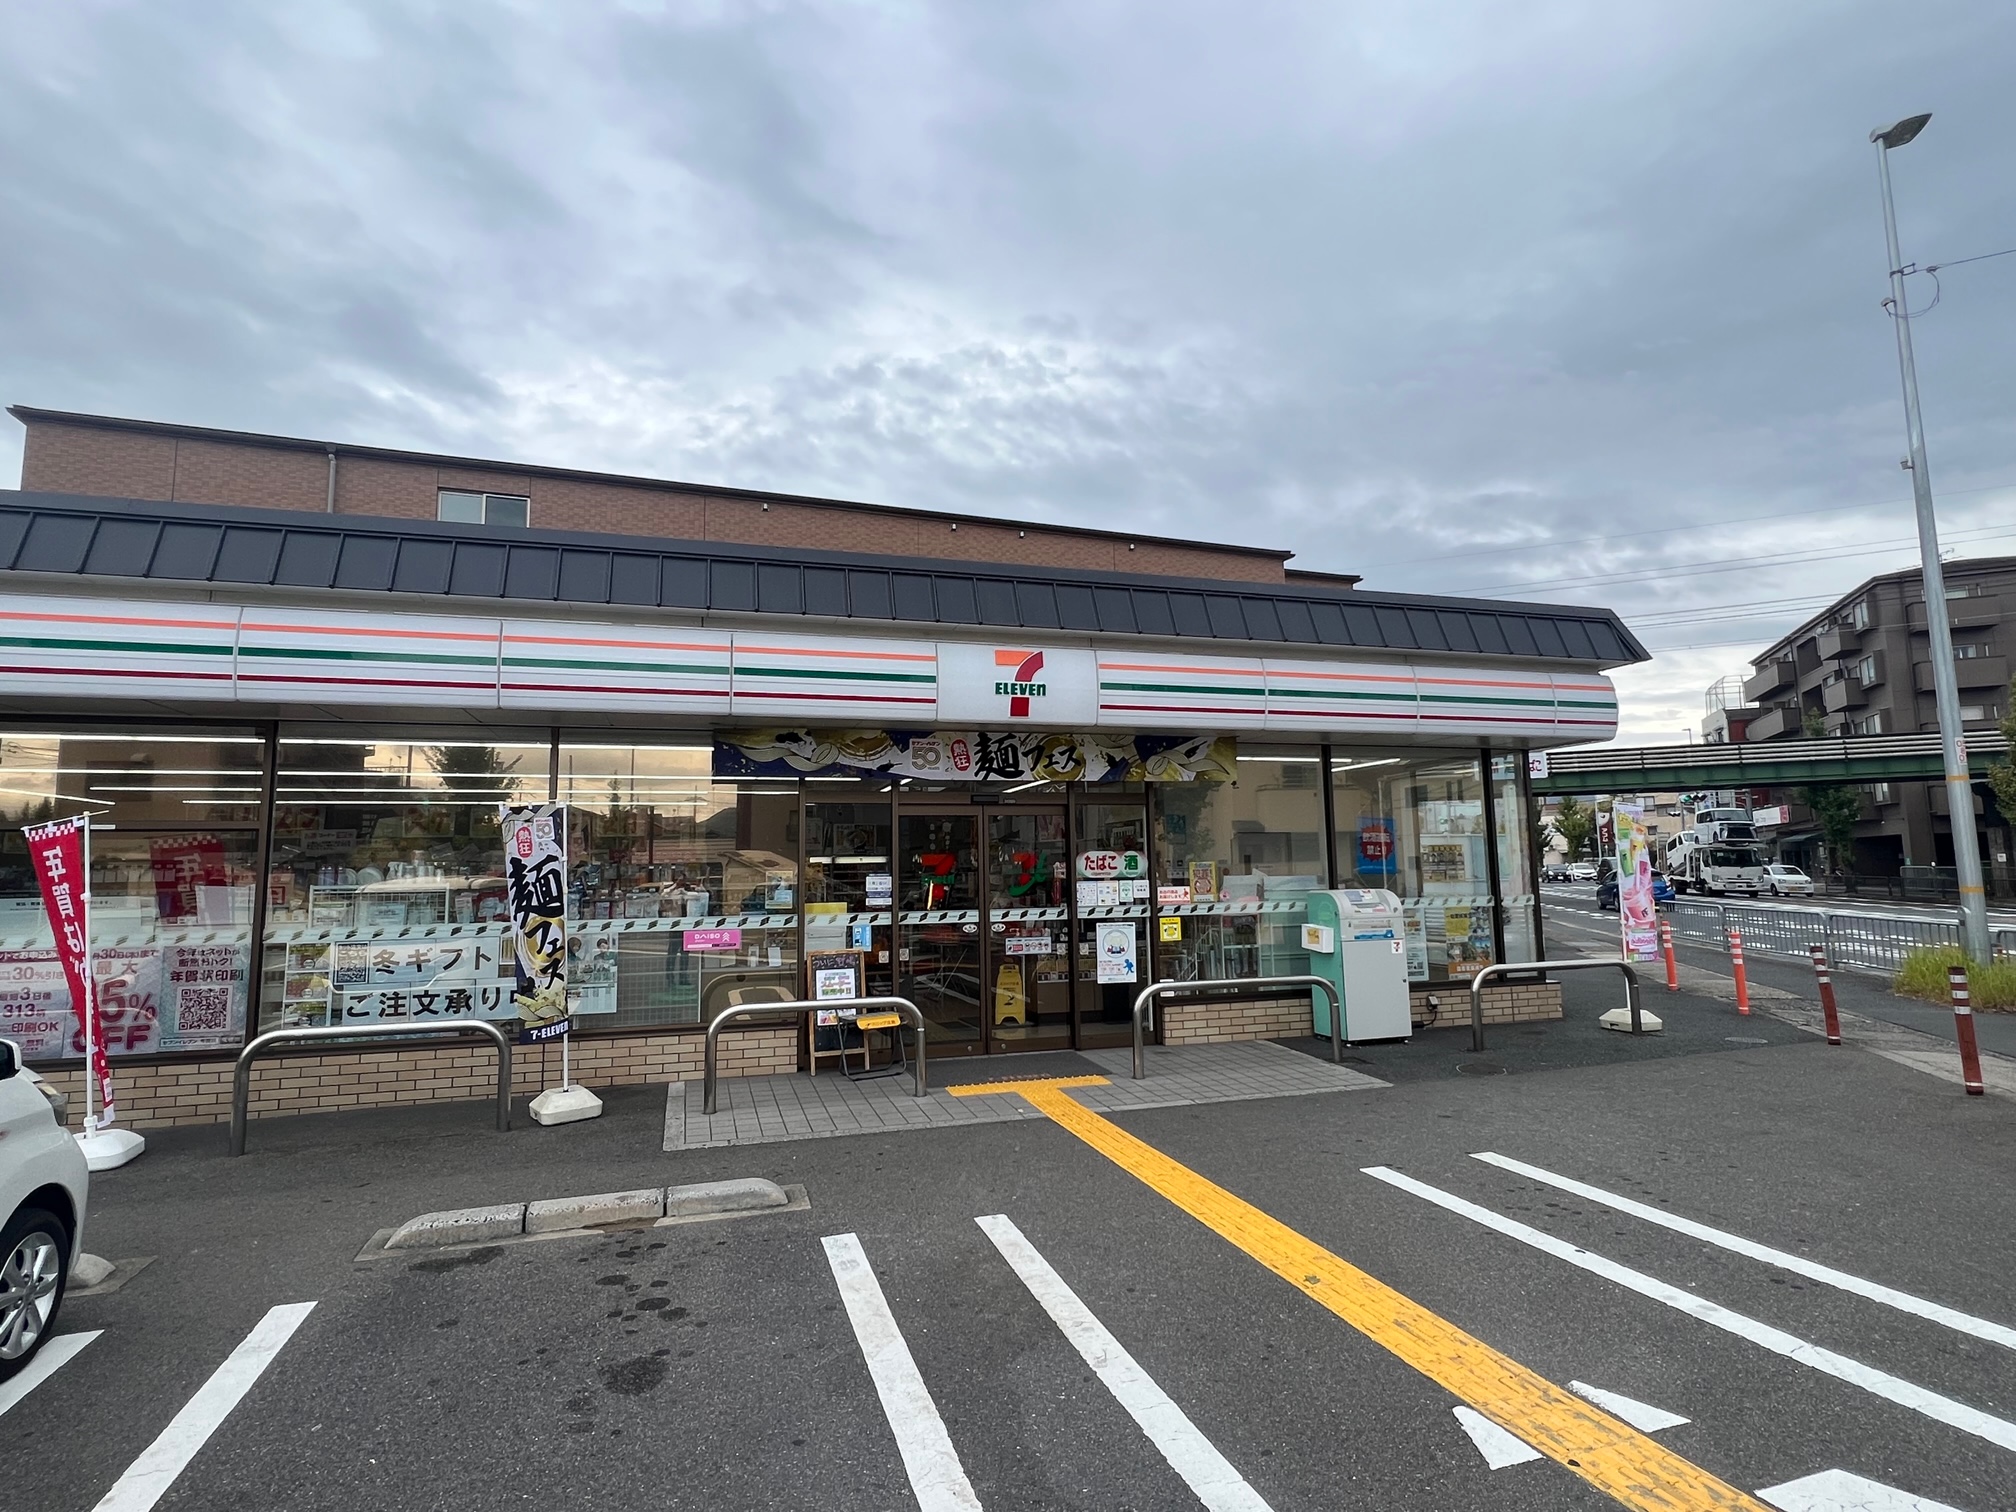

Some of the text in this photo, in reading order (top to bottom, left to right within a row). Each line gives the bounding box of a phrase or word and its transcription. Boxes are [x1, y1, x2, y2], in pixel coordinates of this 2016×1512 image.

[995, 650, 1044, 717] 7
[912, 747, 941, 770] 50
[1530, 760, 1542, 771] ばこ
[1084, 854, 1139, 871] たばこ 酒
[508, 854, 565, 989] 麺フェス
[373, 946, 492, 975] 冬ギフト
[170, 969, 244, 982] 年賀状印刷
